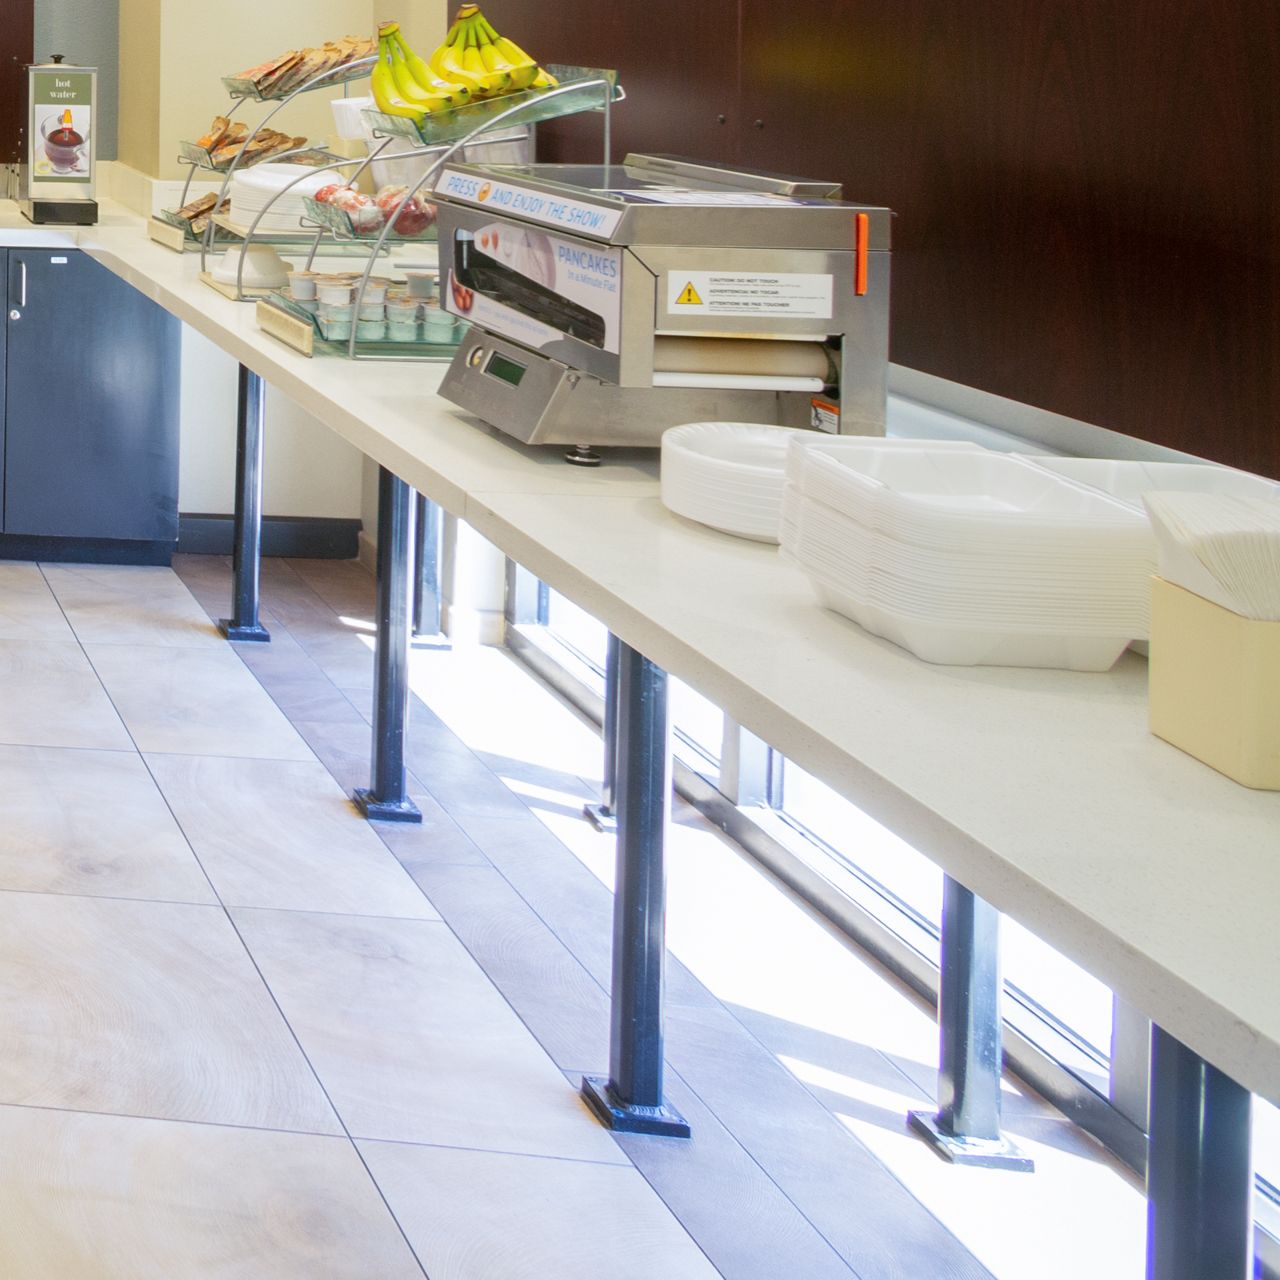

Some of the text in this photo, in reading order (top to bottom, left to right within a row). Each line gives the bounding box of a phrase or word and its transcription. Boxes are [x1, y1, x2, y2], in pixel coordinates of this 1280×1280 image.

[55, 78, 71, 88] hot
[49, 90, 78, 99] water
[447, 176, 607, 229] PRESS AND ENJOY THE SHOW!
[558, 245, 617, 278] PANCAKES
